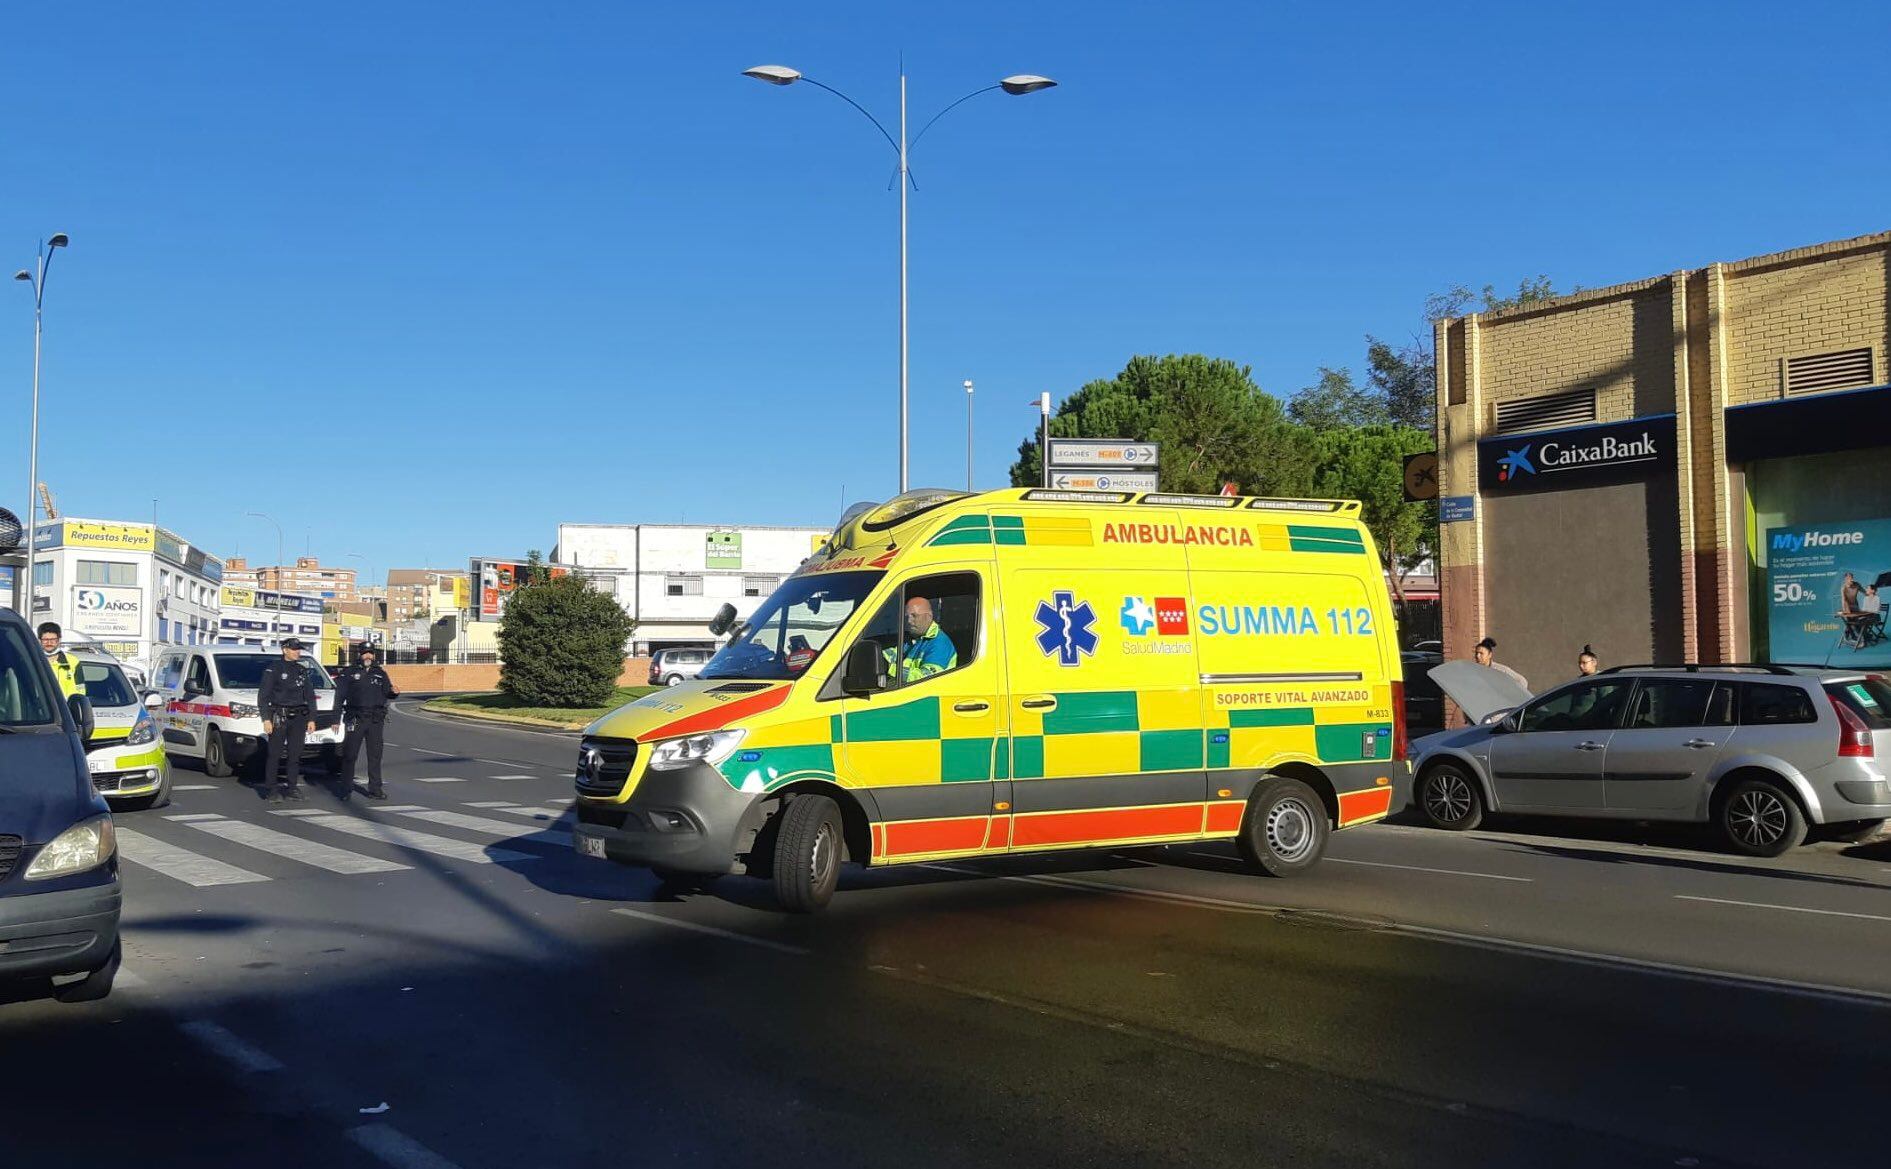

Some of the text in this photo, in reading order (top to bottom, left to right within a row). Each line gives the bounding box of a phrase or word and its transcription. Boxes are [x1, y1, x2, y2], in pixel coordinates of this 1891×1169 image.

[1539, 432, 1658, 466] CaixaBank
[71, 531, 149, 545] Repuestos Reyes
[1103, 522, 1254, 546] AMBULANCIA
[1772, 531, 1864, 552] MyHome
[104, 600, 137, 611] AÑOS
[1200, 606, 1372, 635] SUMMA 112
[1122, 641, 1192, 655] SaludMadrid
[1217, 690, 1369, 705] SOPORTE VITAL AVANZADO
[1366, 709, 1390, 718] M-833
